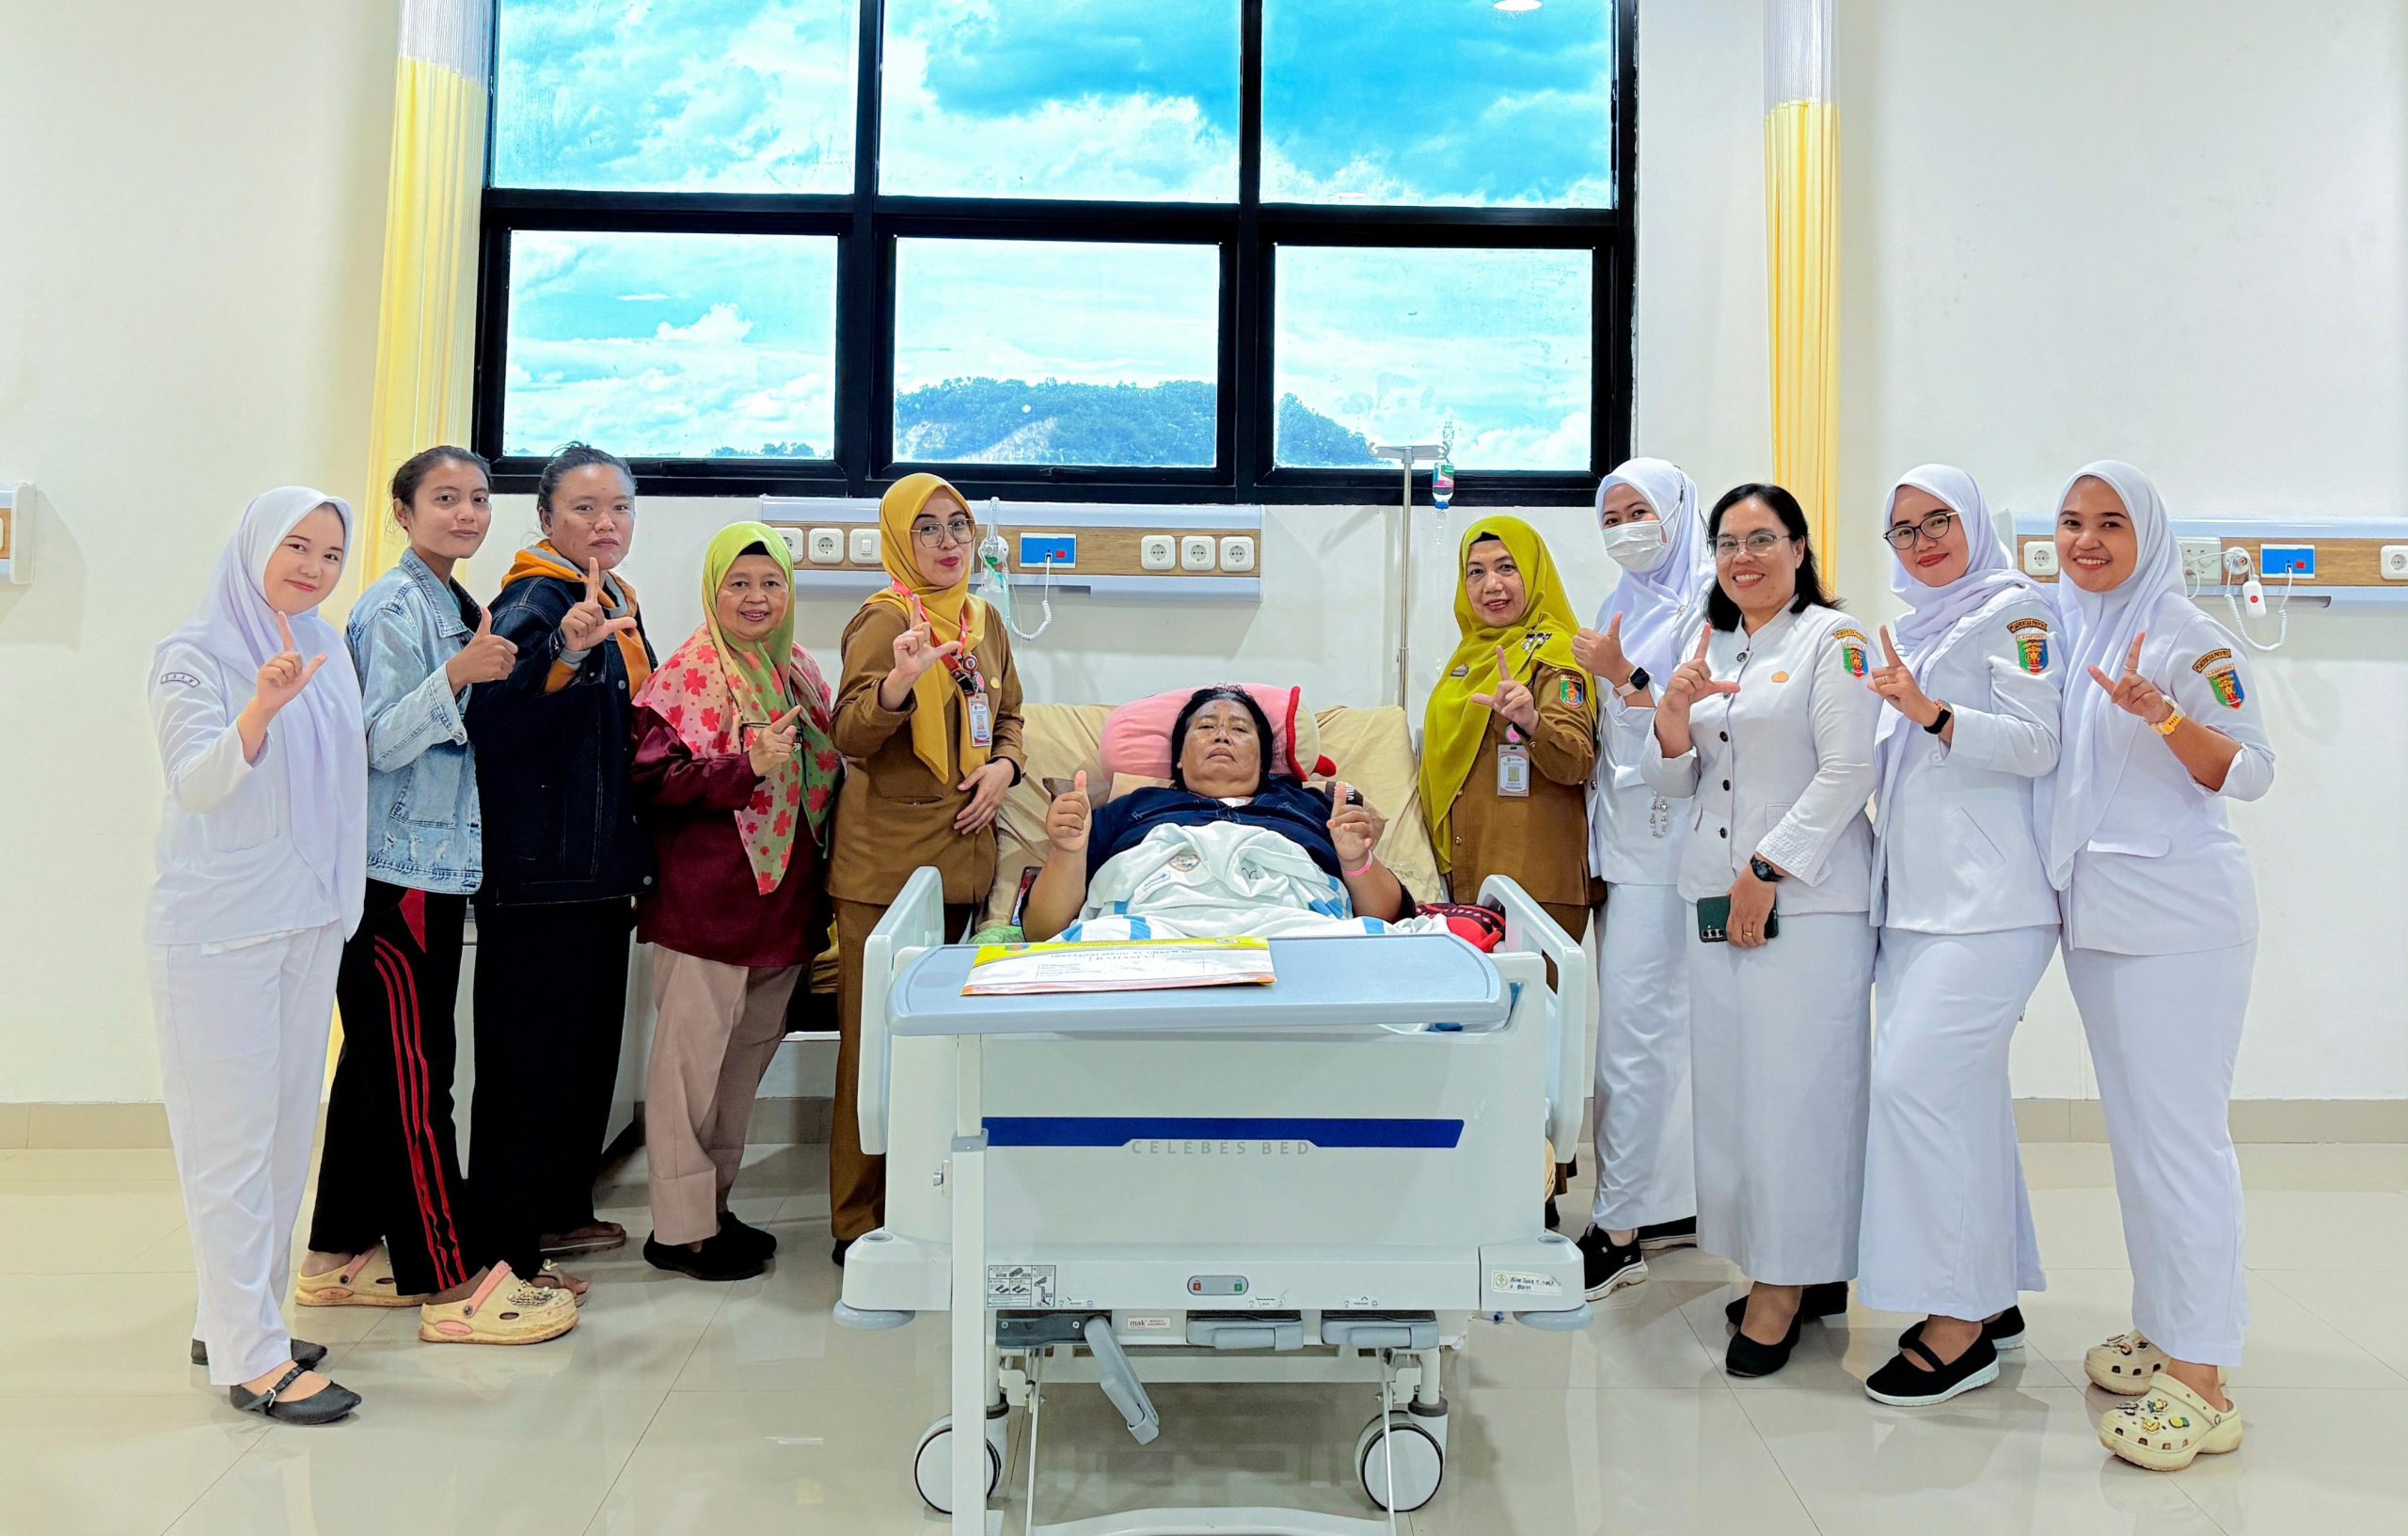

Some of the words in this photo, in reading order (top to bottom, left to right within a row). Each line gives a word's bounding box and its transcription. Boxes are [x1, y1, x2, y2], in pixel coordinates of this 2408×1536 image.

[1132, 1140, 1246, 1155] CELEBES
[1261, 1141, 1308, 1155] BED
[1130, 1319, 1145, 1327] mak
